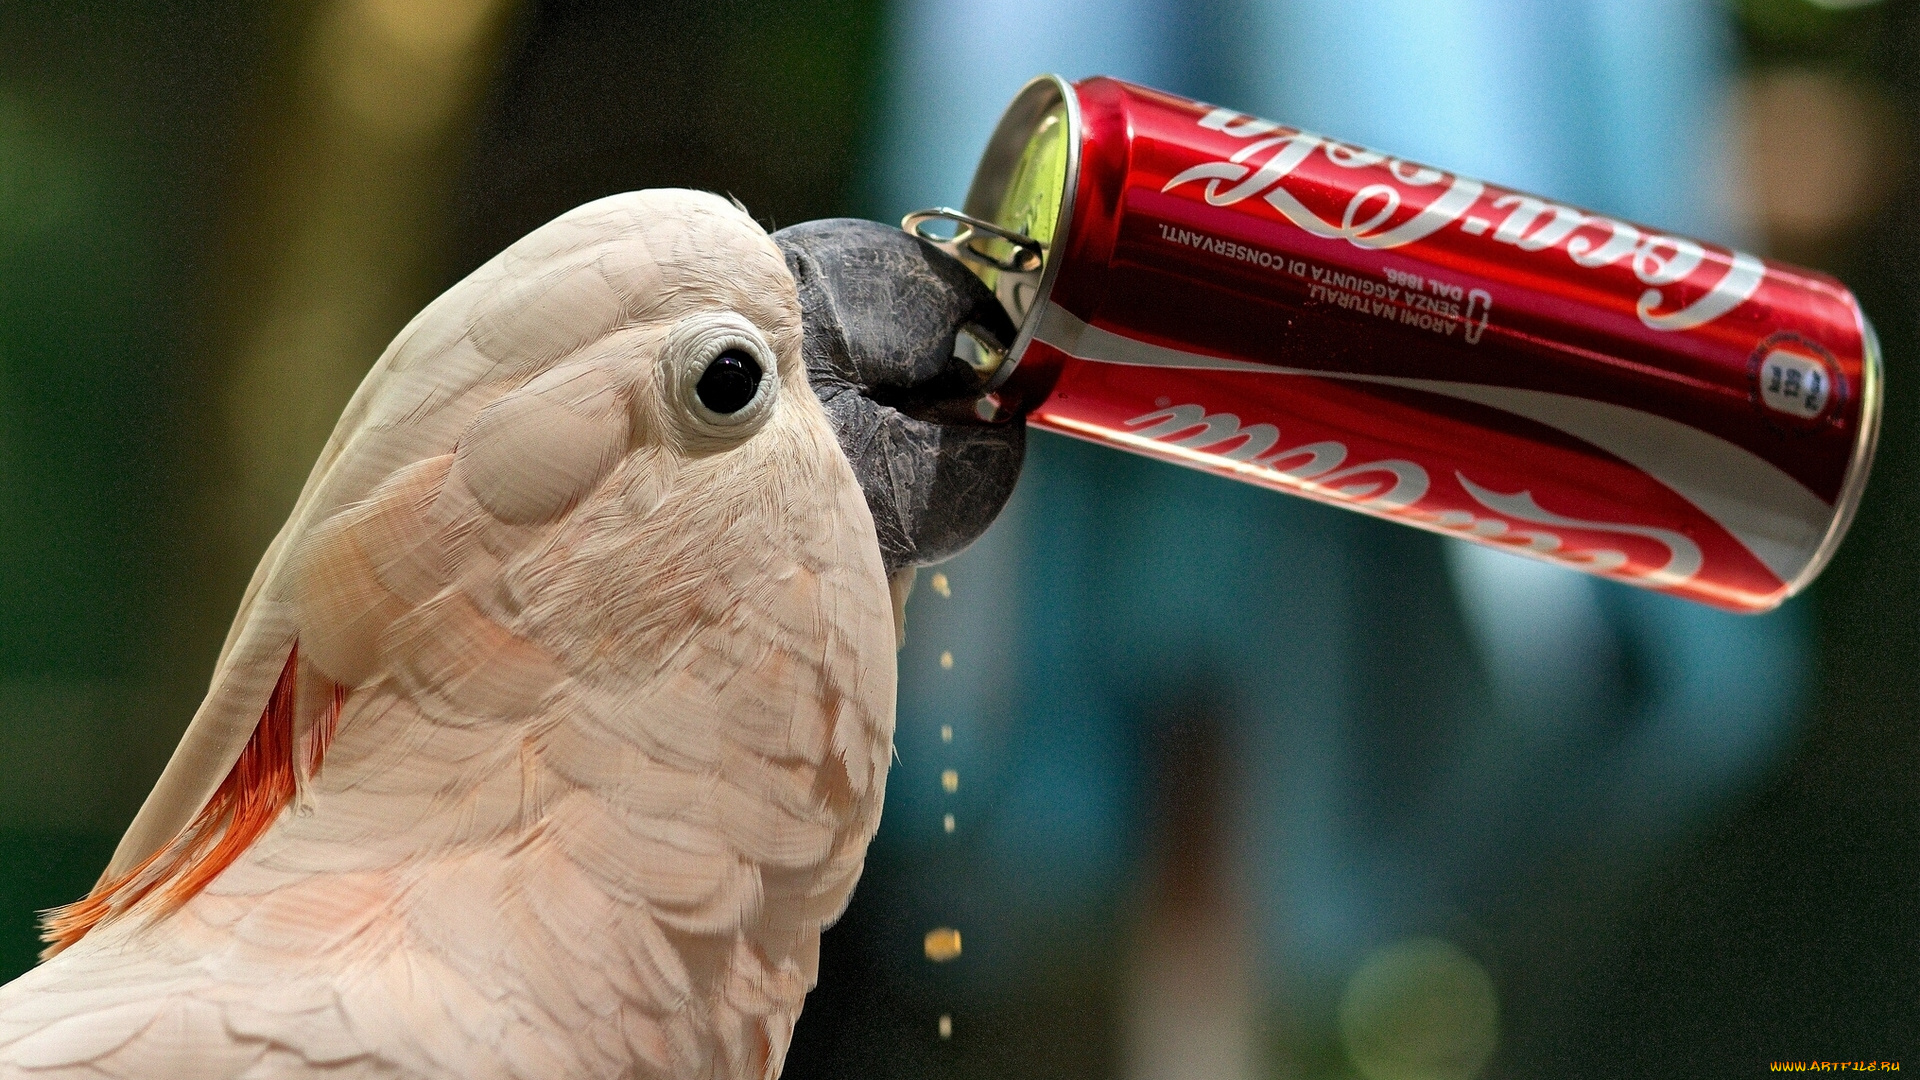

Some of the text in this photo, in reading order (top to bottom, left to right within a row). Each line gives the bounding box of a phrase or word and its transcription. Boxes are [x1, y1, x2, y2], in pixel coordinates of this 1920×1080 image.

[1158, 223, 1460, 319] SENZA AGGIUNTA DI CONSERVANTI.
[1428, 279, 1463, 301] DAL
[1400, 309, 1458, 336] AROMI
